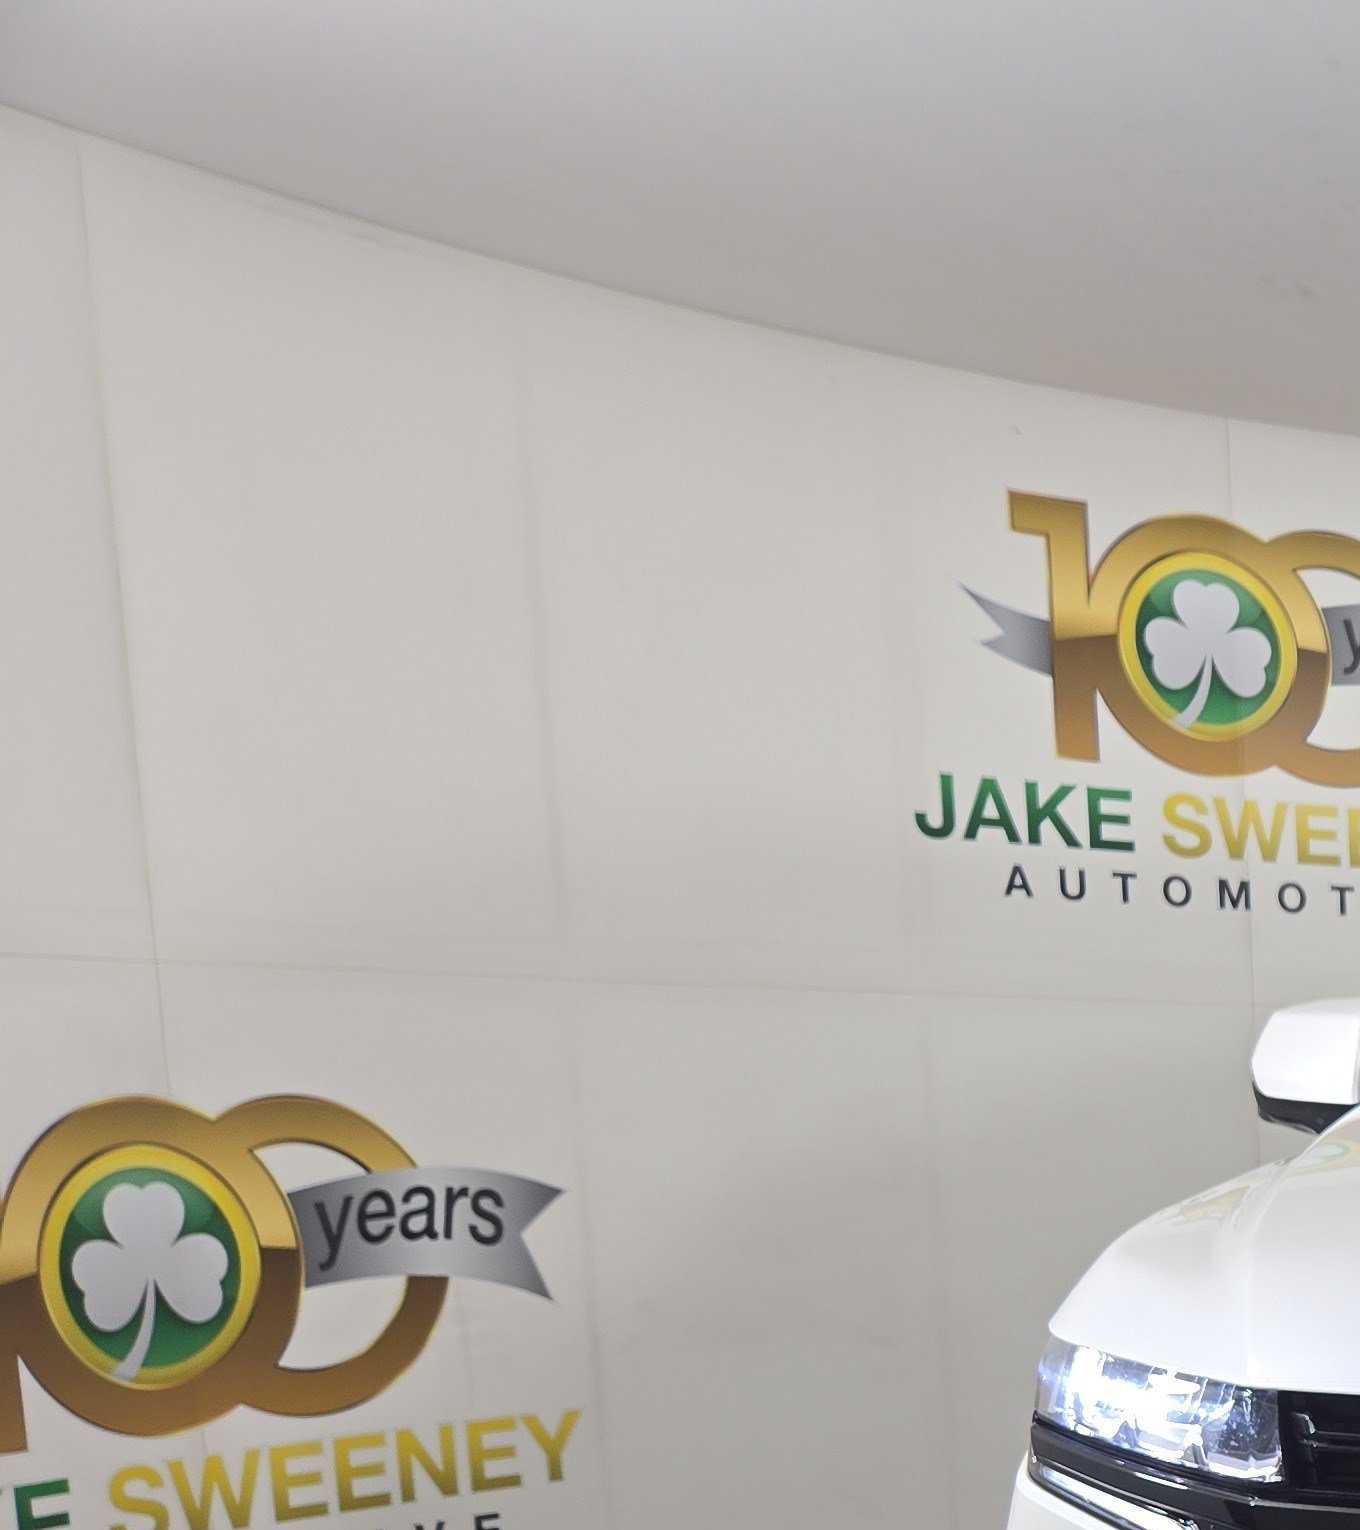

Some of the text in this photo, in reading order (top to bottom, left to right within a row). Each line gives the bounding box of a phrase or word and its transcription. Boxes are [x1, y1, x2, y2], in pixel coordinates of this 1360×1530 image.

[914, 772, 1136, 853] JAKE
[313, 1183, 505, 1271] years
[0, 1093, 449, 1456] 00
